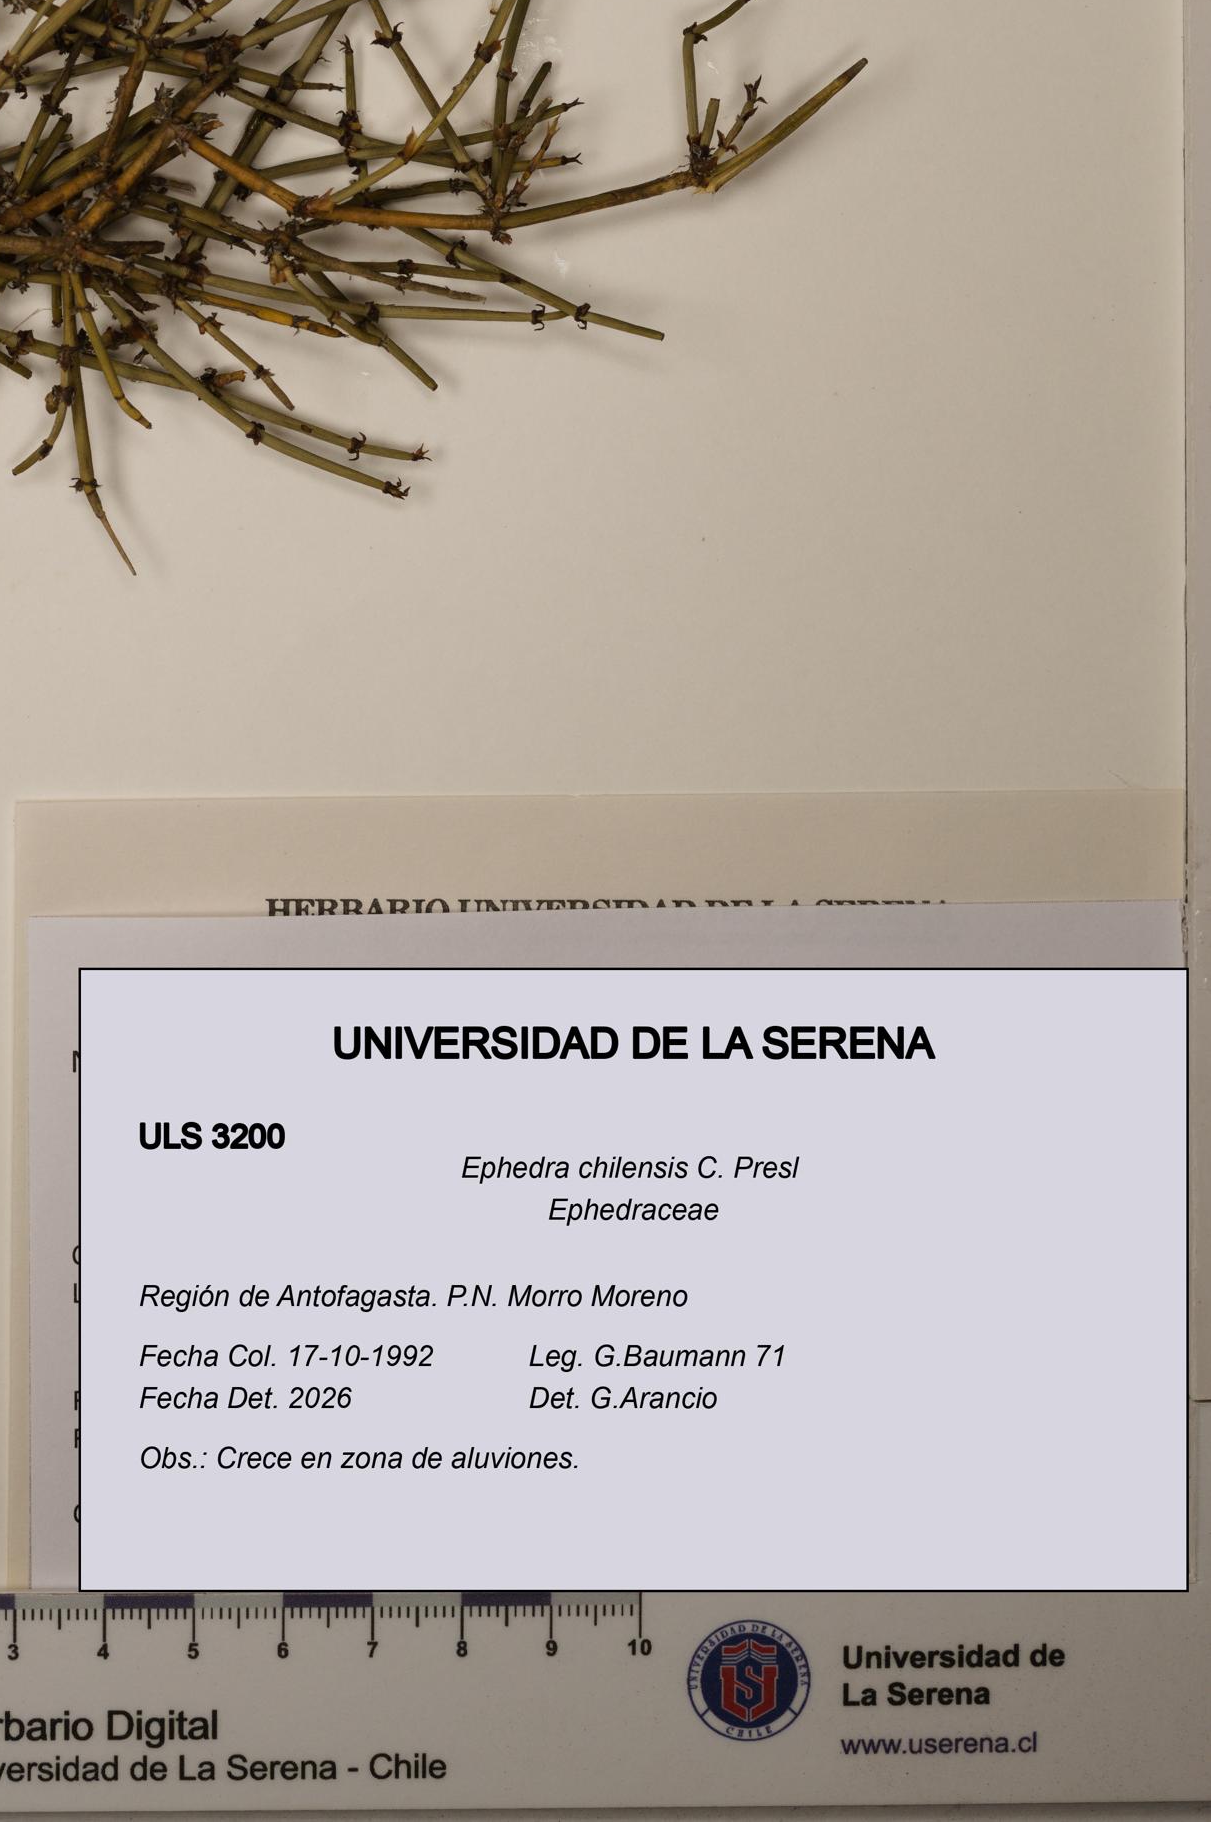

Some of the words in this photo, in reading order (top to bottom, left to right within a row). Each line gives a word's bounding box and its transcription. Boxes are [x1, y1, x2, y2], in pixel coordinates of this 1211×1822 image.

[751, 1624, 767, 1634] DE
[7, 1643, 20, 1661] 3
[96, 1642, 110, 1661] 4
[187, 1642, 200, 1660] 5
[276, 1641, 290, 1660] 6
[366, 1640, 379, 1659] 7
[455, 1640, 468, 1658] 8
[545, 1639, 558, 1657] 9
[627, 1638, 653, 1657] 10
[842, 1643, 1020, 1670] Universidad
[1029, 1642, 1066, 1668] de
[842, 1682, 878, 1707] La
[886, 1681, 991, 1707] Serena
[106, 1708, 218, 1748] Digital
[725, 1726, 773, 1738] CHILE
[840, 1730, 1038, 1756] www.userena.cl
[129, 1754, 168, 1782] de
[178, 1754, 216, 1782] La
[226, 1753, 337, 1782] Serena
[369, 1752, 447, 1780] Chile
